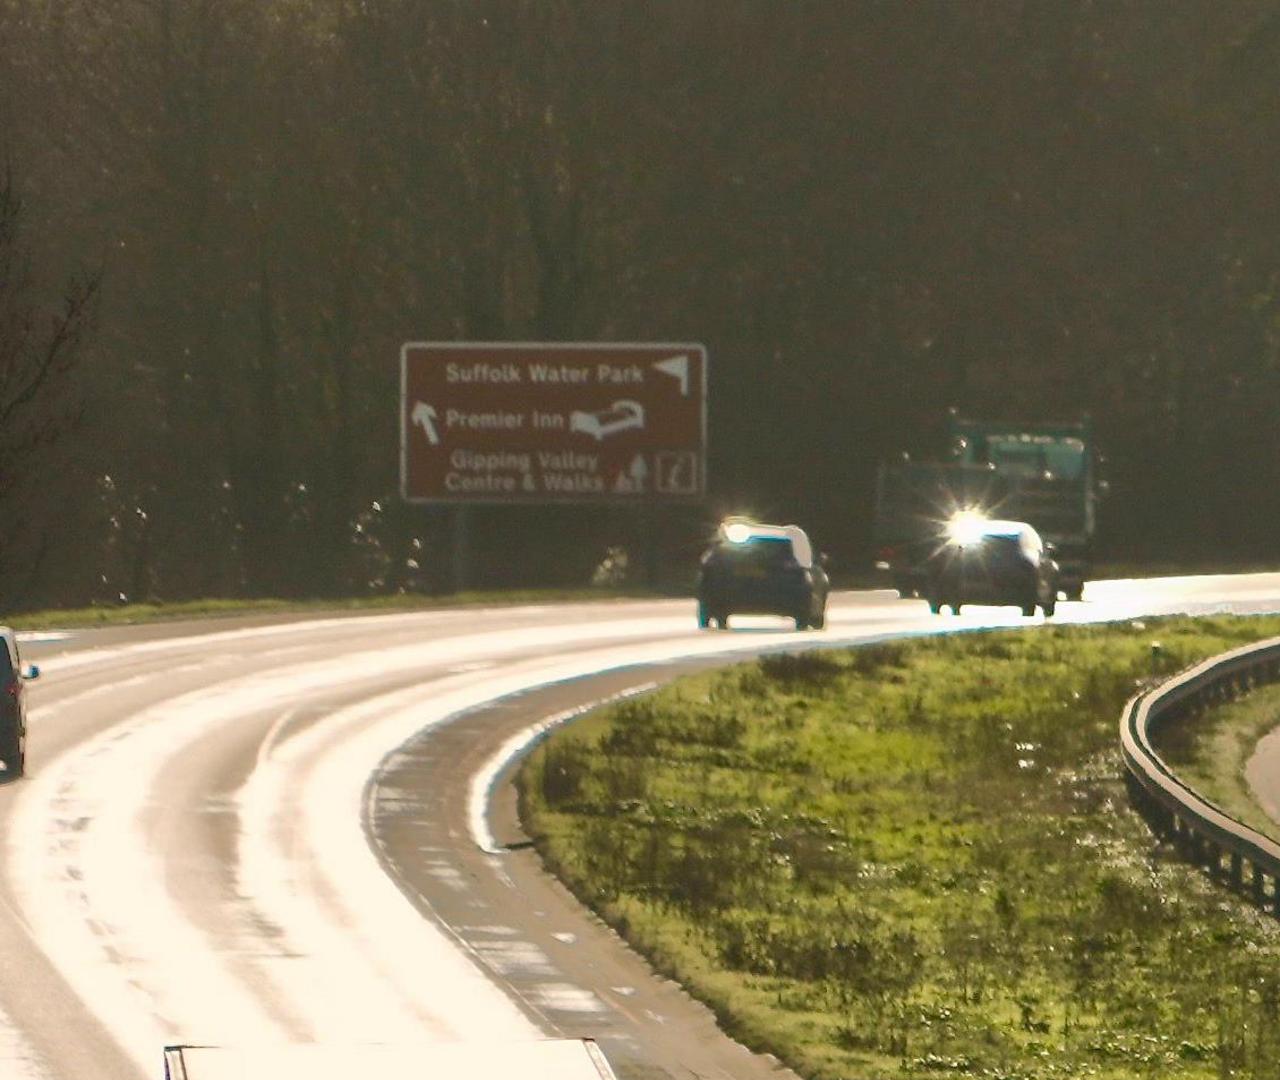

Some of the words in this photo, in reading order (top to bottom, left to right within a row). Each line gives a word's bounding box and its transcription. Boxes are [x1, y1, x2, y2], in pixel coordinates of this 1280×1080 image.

[446, 362, 521, 384] Suffolk
[528, 364, 589, 384] Water
[599, 365, 644, 384] Park
[446, 409, 523, 428] Premier
[533, 410, 563, 428] Inn
[451, 451, 531, 471] Gipping
[538, 451, 599, 472] Valley
[445, 473, 516, 491] Centre
[522, 474, 535, 491] &
[545, 473, 604, 491] Walks
